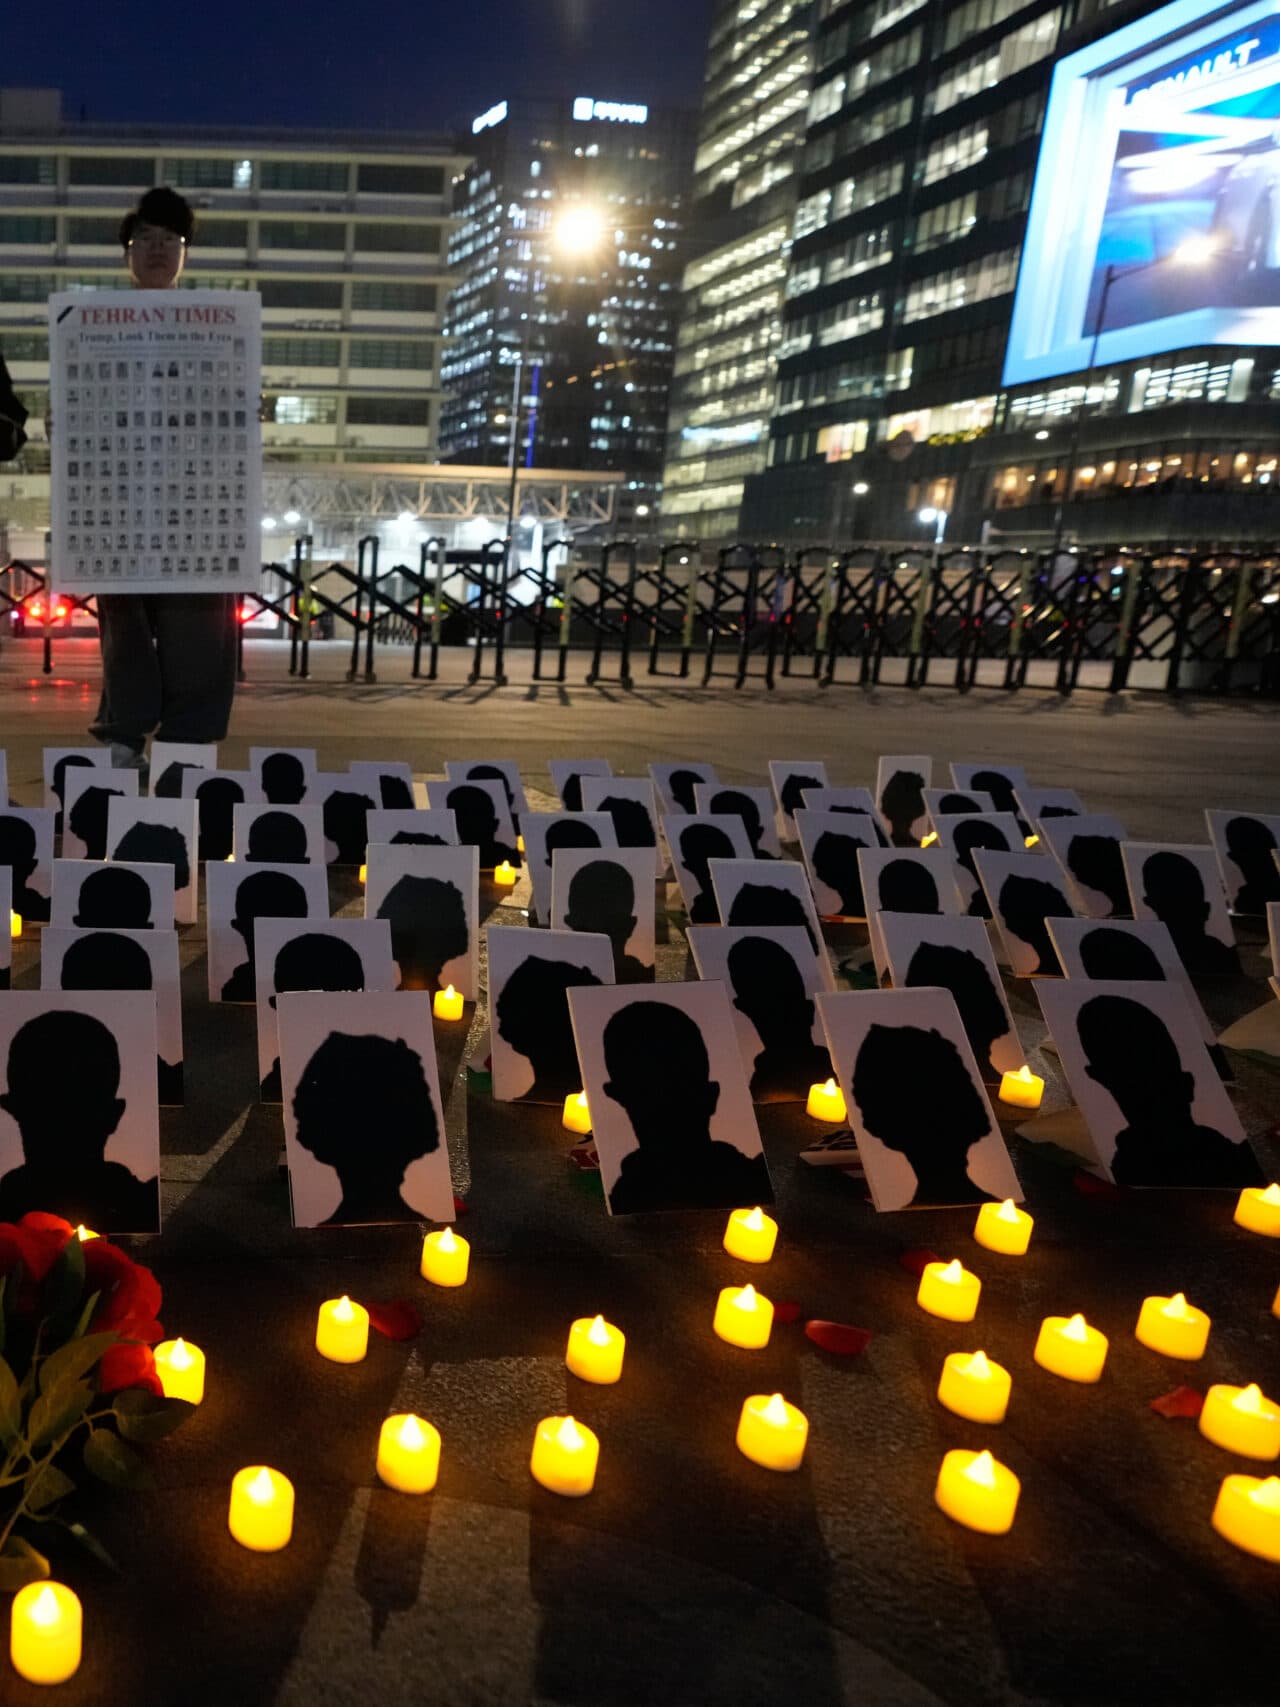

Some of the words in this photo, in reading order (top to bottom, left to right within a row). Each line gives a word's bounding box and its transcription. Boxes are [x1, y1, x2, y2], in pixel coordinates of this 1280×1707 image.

[80, 308, 165, 325] TEHRAN
[174, 308, 236, 325] TIMES
[119, 331, 144, 342] Look
